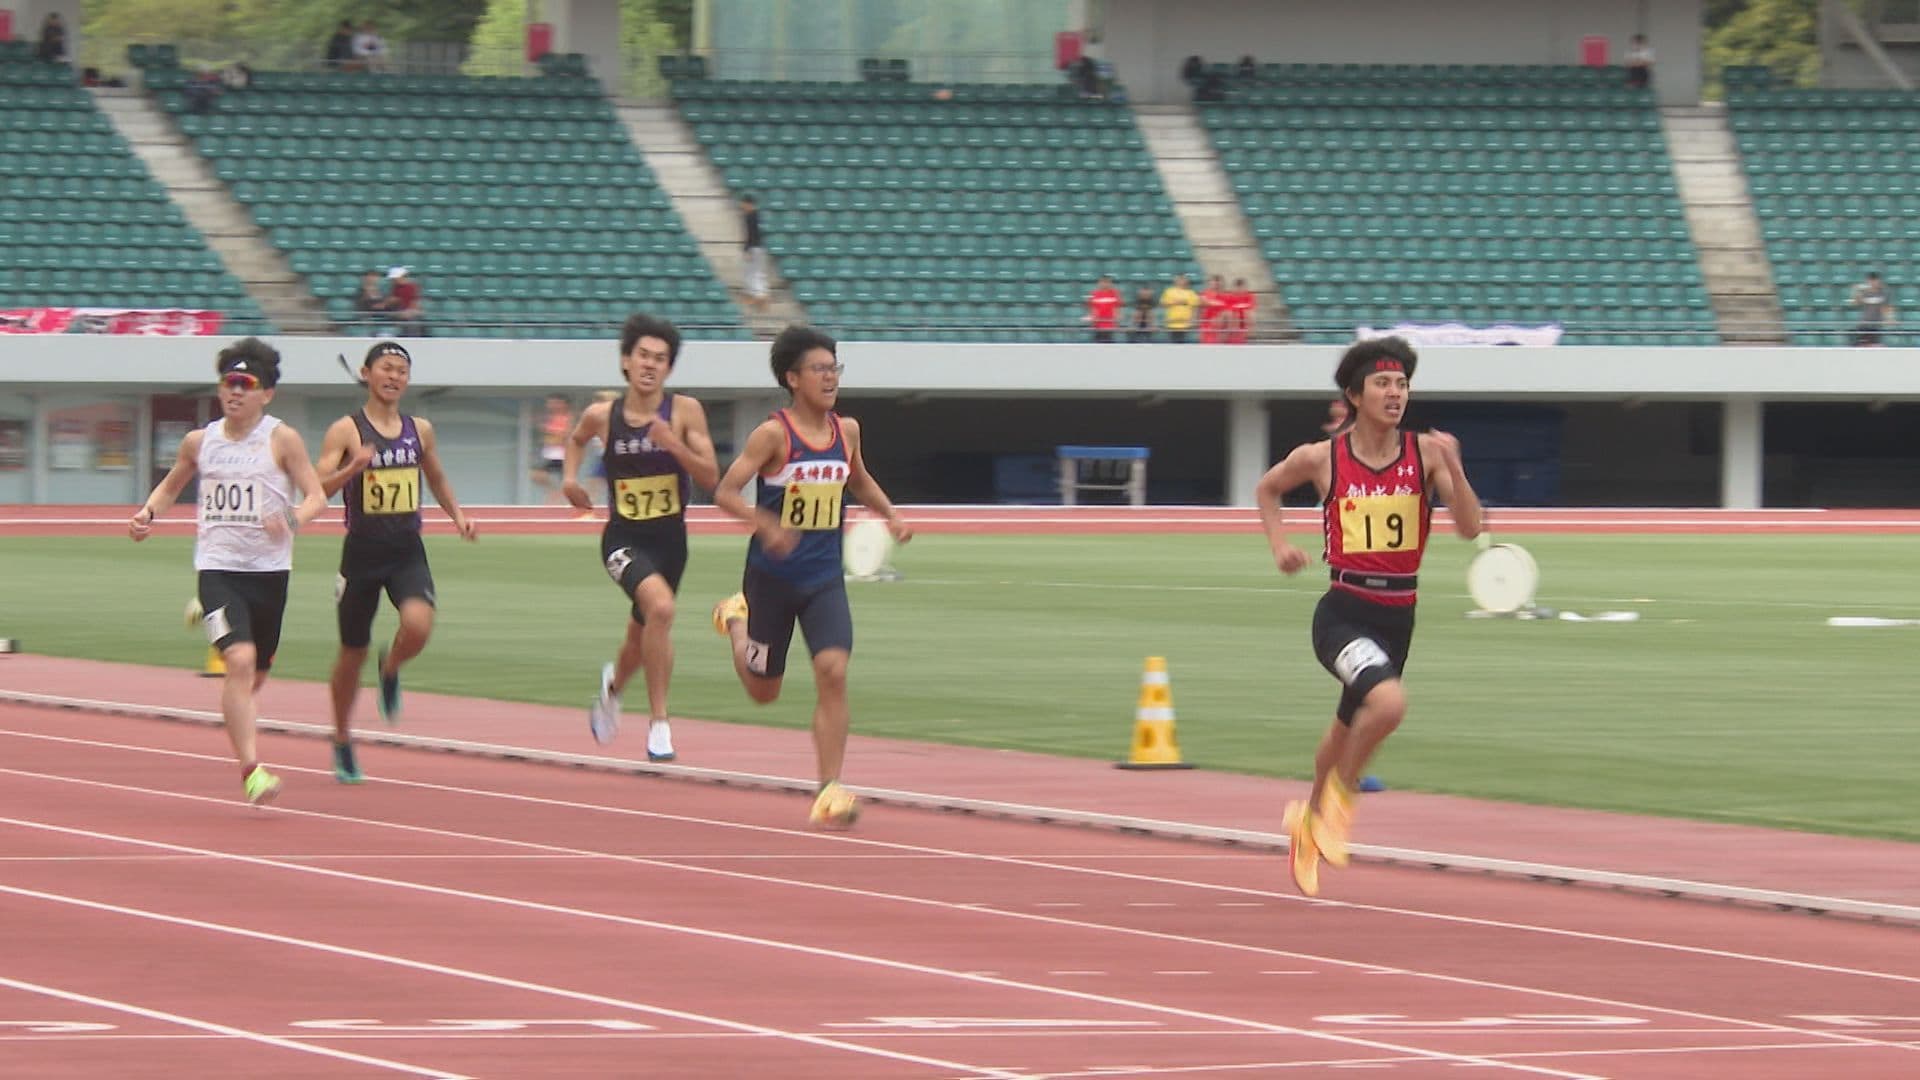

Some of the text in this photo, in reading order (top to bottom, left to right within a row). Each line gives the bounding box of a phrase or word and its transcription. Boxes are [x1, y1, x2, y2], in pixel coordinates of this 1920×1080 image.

[370, 482, 414, 511] 971
[623, 489, 673, 518] 973
[790, 496, 835, 528] 811
[1364, 513, 1404, 550] 19
